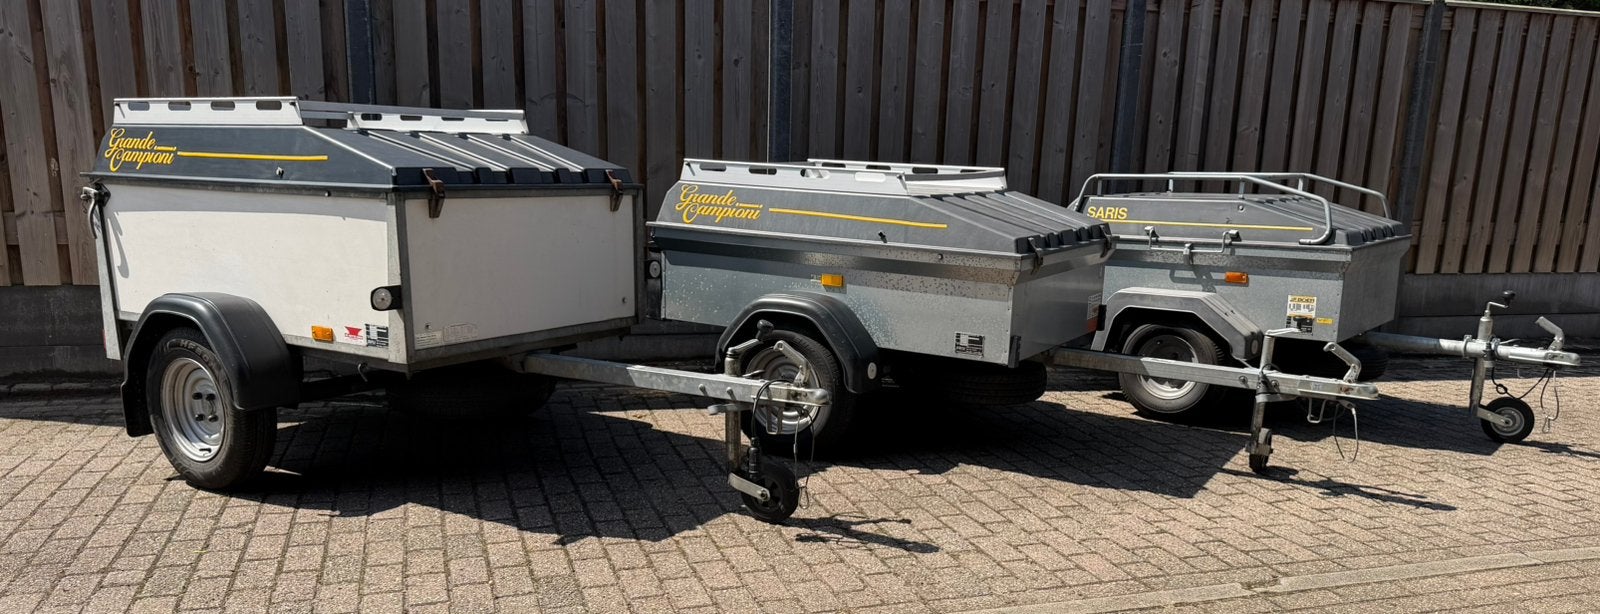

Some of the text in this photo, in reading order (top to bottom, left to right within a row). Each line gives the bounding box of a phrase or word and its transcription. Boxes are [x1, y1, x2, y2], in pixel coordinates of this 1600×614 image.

[105, 128, 156, 158] Grande
[108, 148, 176, 173] Campioni
[675, 185, 737, 210] Grande
[681, 203, 761, 224] Campioni
[1086, 206, 1128, 220] SARIS
